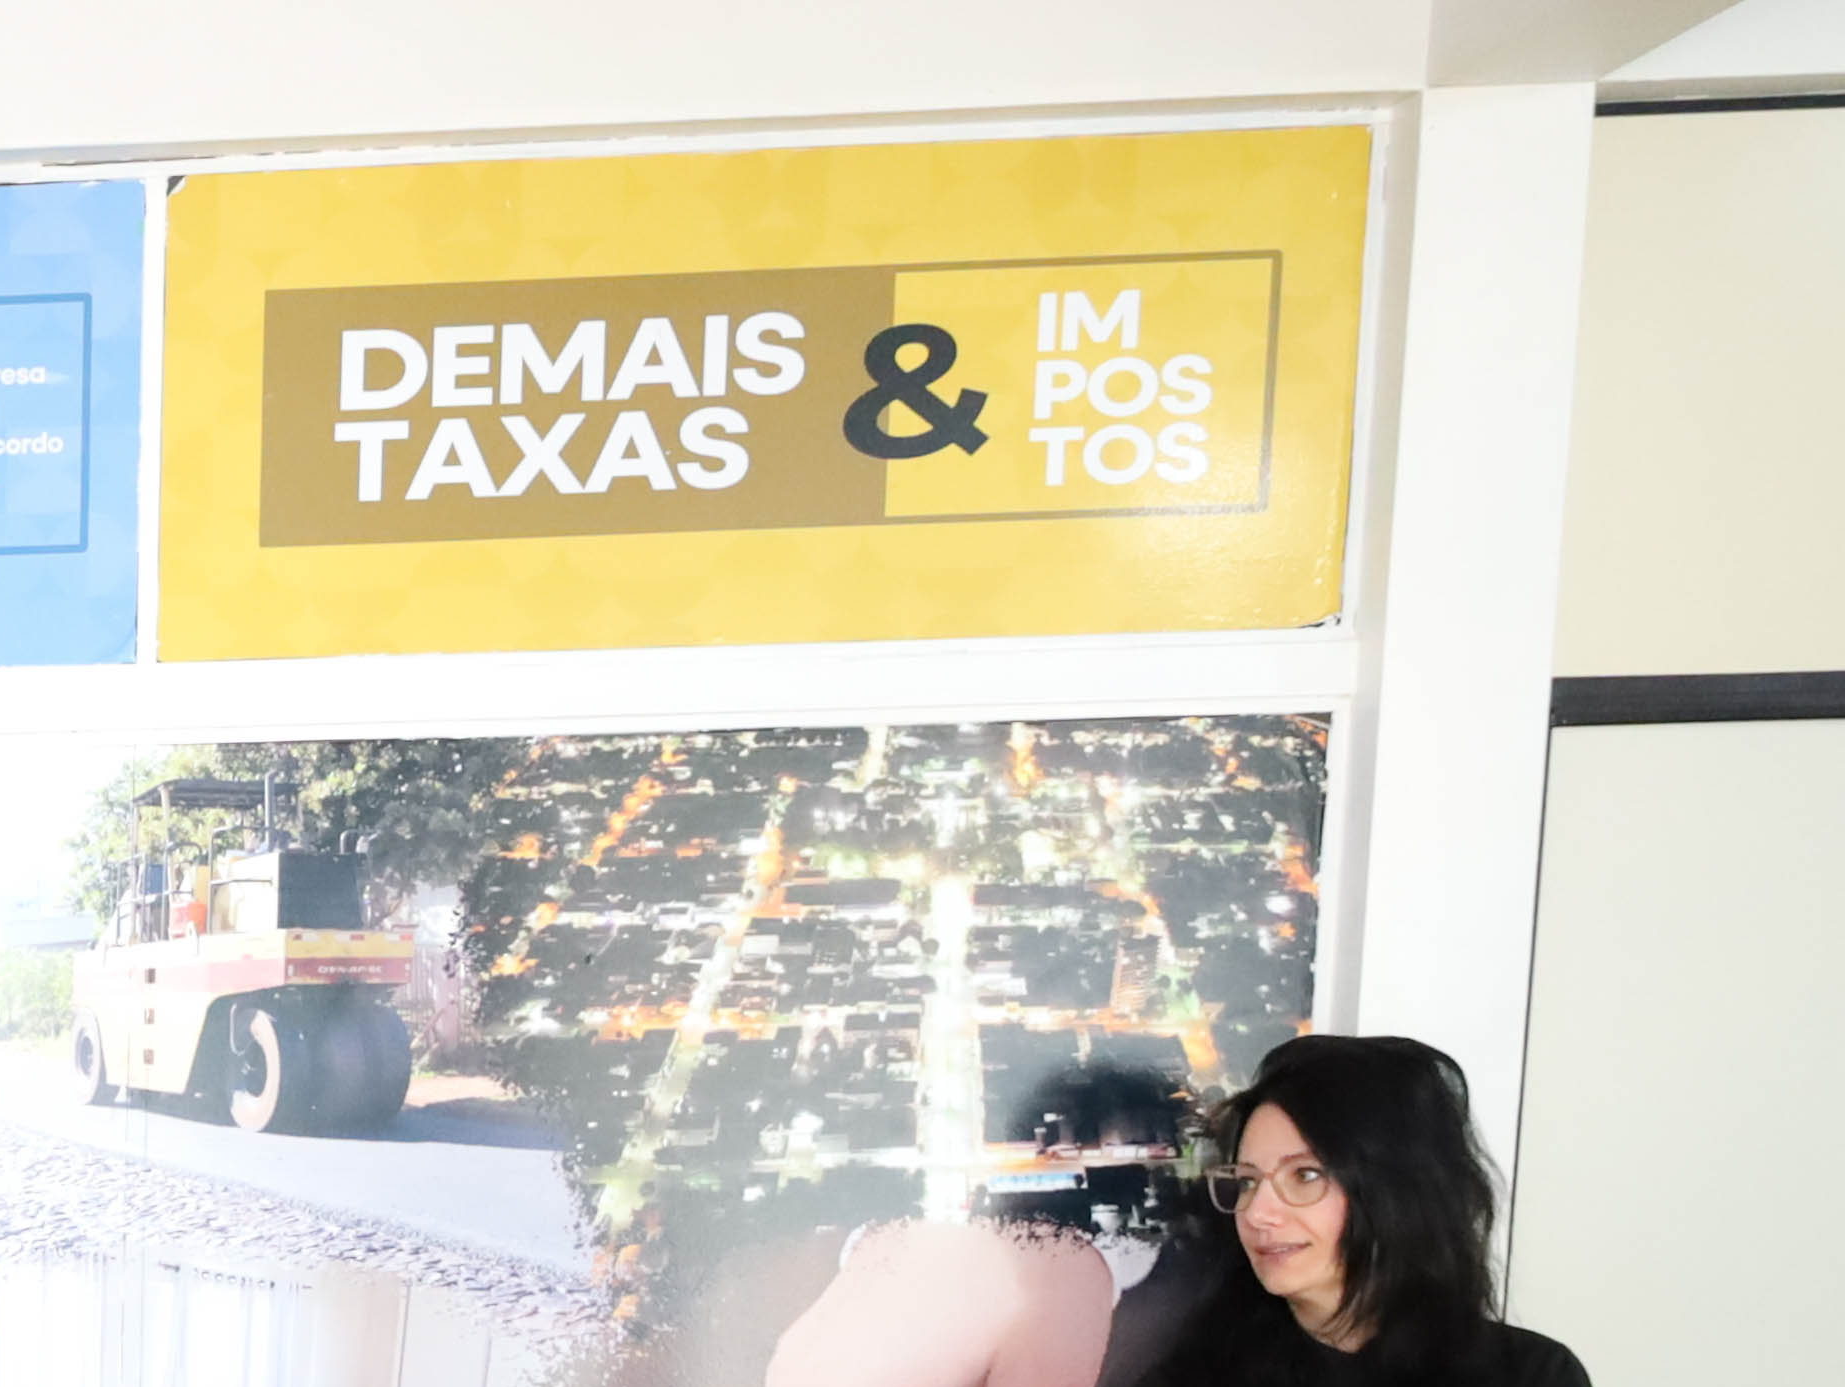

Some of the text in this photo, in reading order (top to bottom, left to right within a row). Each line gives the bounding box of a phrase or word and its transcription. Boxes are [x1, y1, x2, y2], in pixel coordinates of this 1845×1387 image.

[1036, 288, 1143, 353] IM
[339, 311, 807, 413] DEMAIS
[842, 322, 990, 461] &
[1034, 353, 1215, 420] POS
[333, 406, 751, 502] TAXAS
[1029, 421, 1211, 487] TOS
